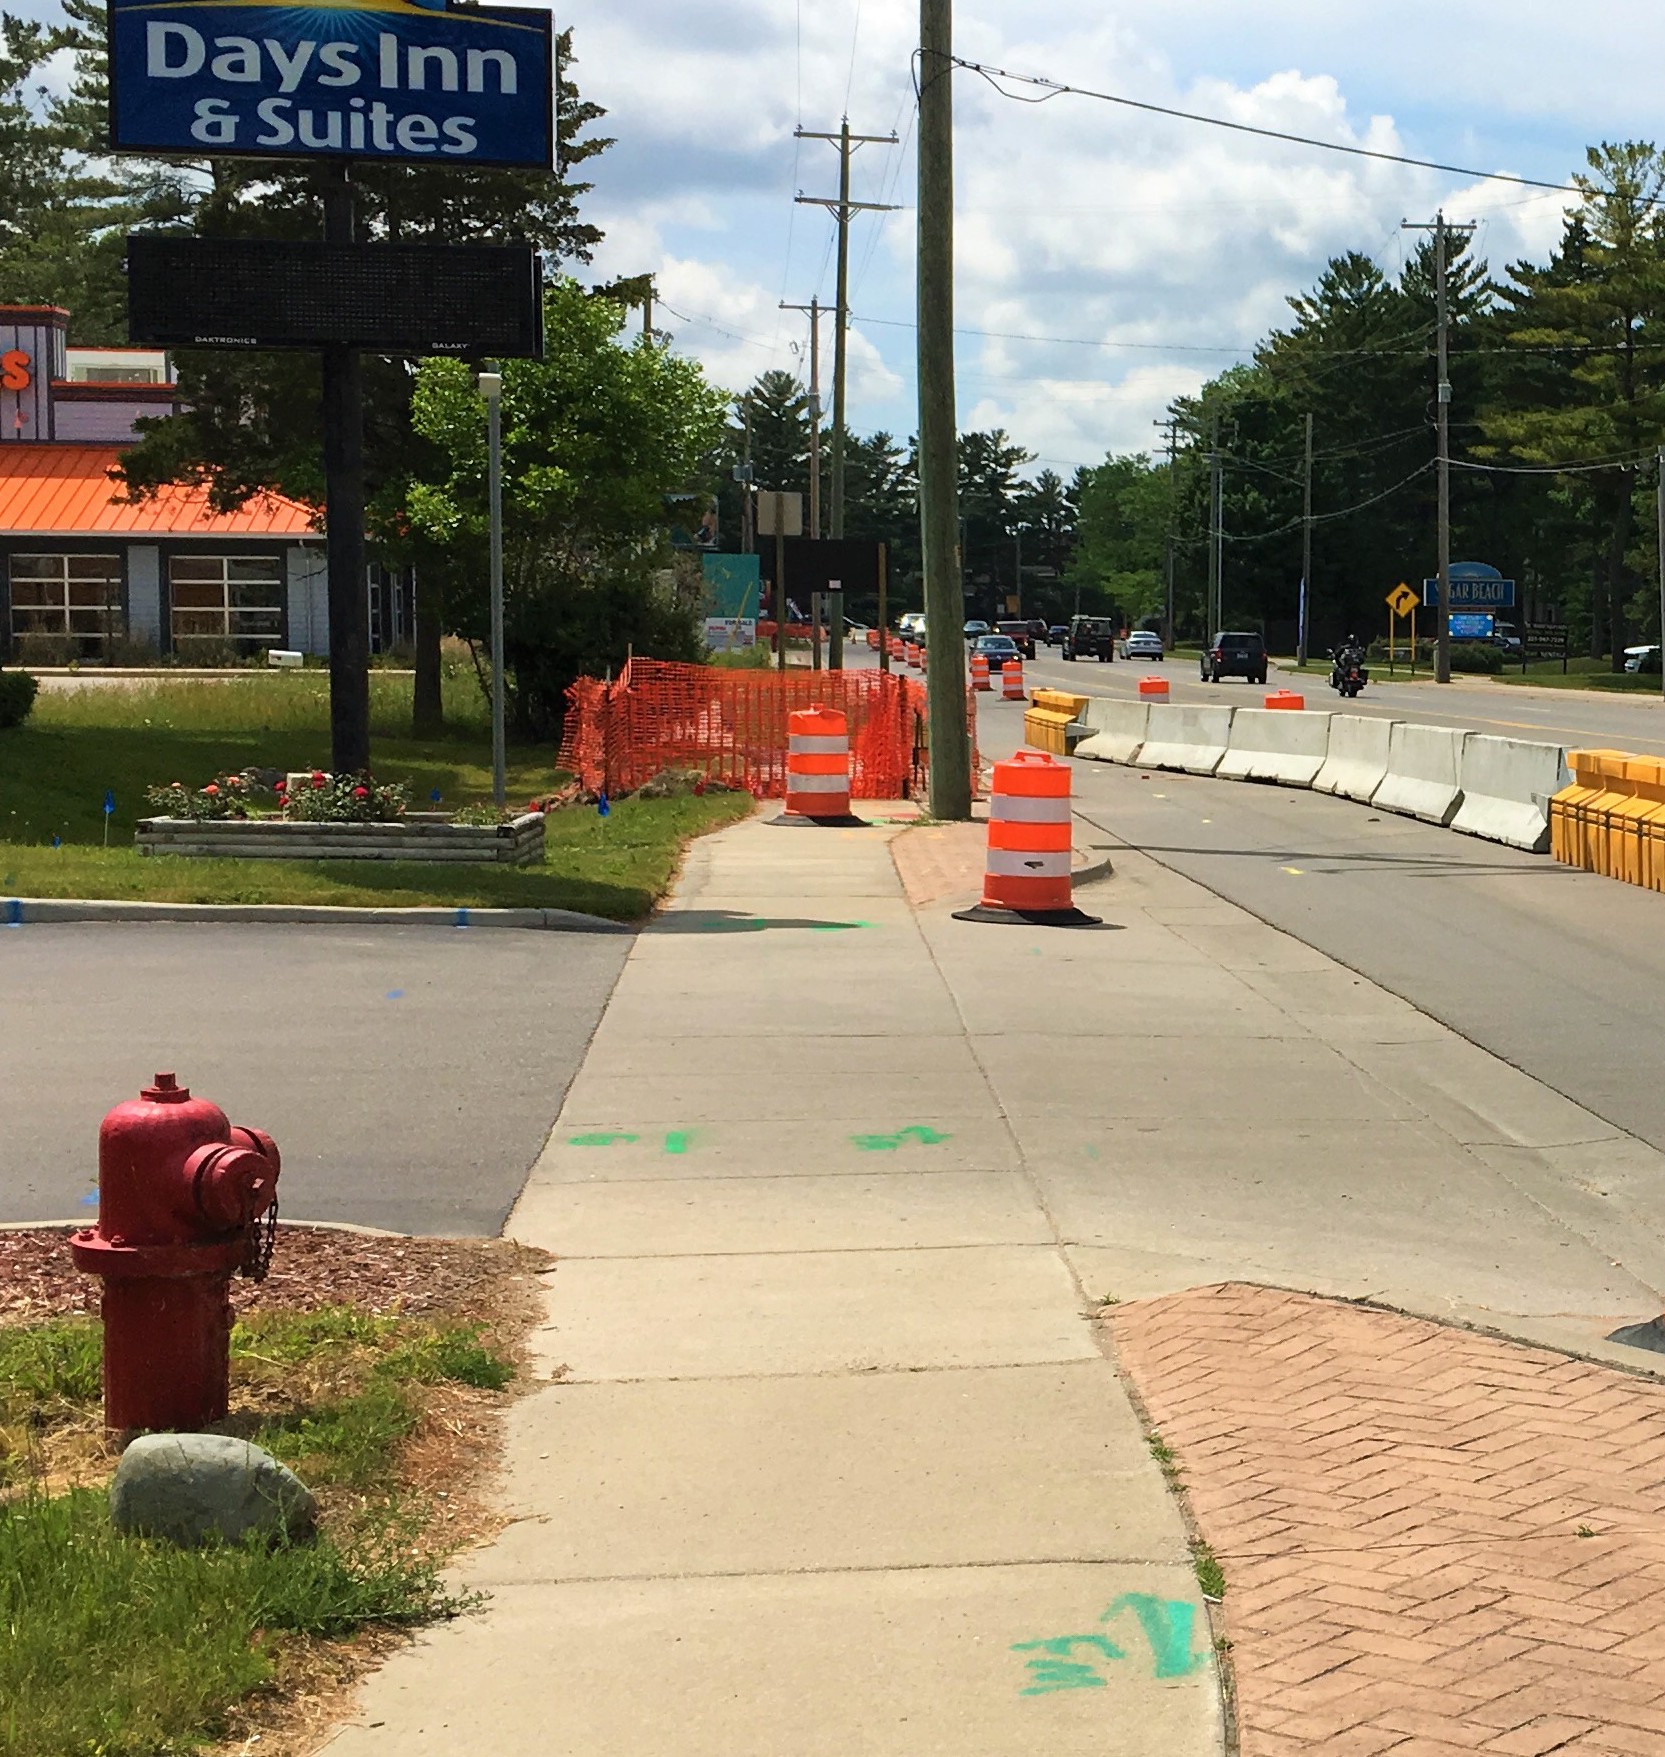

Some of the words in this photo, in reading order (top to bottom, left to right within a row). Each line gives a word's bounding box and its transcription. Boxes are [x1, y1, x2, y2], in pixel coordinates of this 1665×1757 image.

[147, 20, 360, 92] Days
[380, 32, 518, 95] Inn
[190, 98, 240, 144] &
[256, 97, 478, 154] Suites
[194, 336, 257, 345] DAKTRONICS
[1472, 582, 1505, 600] BEACH
